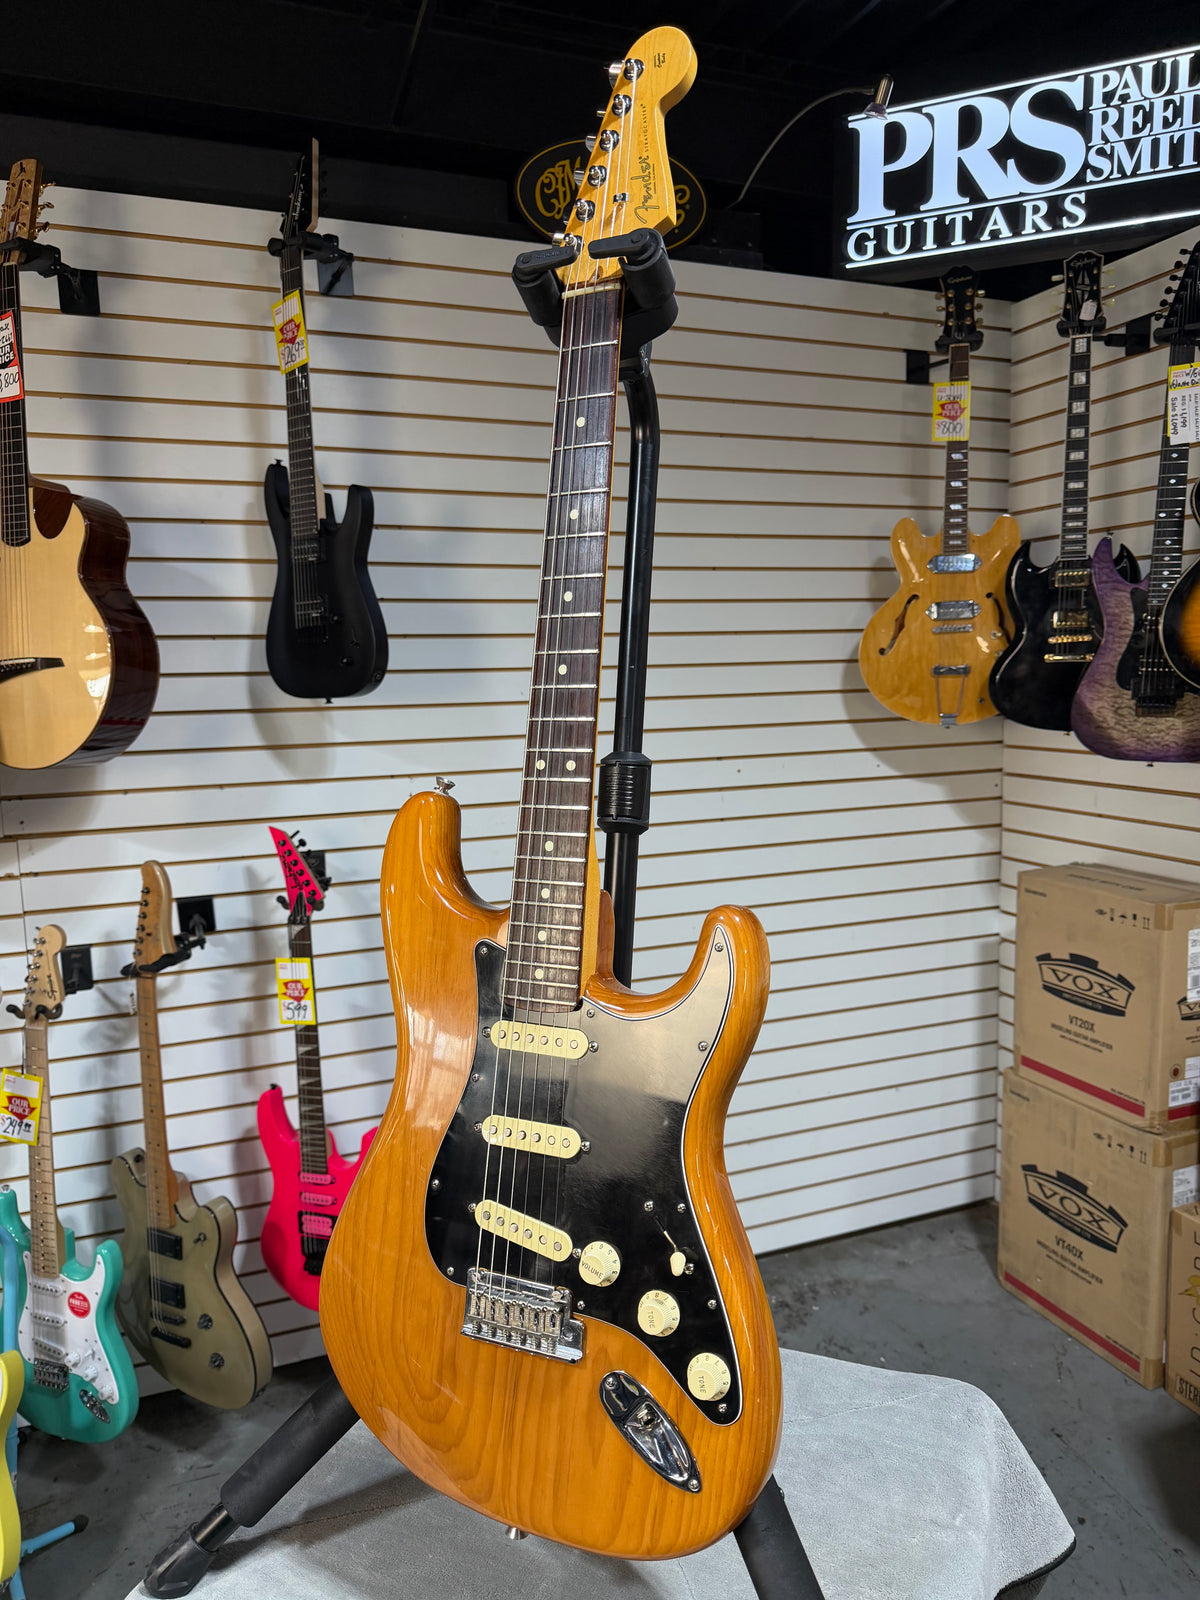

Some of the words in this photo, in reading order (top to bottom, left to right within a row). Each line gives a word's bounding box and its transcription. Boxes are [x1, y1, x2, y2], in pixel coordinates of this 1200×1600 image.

[1089, 53, 1200, 110] PAUL
[847, 75, 1086, 224] PRS
[630, 155, 660, 225] Fender
[847, 192, 1087, 262] GUITARS
[1046, 966, 1120, 1002] VOX
[8, 1103, 31, 1116] PRICE
[11, 1097, 29, 1109] OUR
[1033, 1178, 1110, 1236] VOX
[581, 1260, 604, 1280] VOLUME
[647, 1311, 656, 1329] TONE
[698, 1375, 707, 1394] TONE
